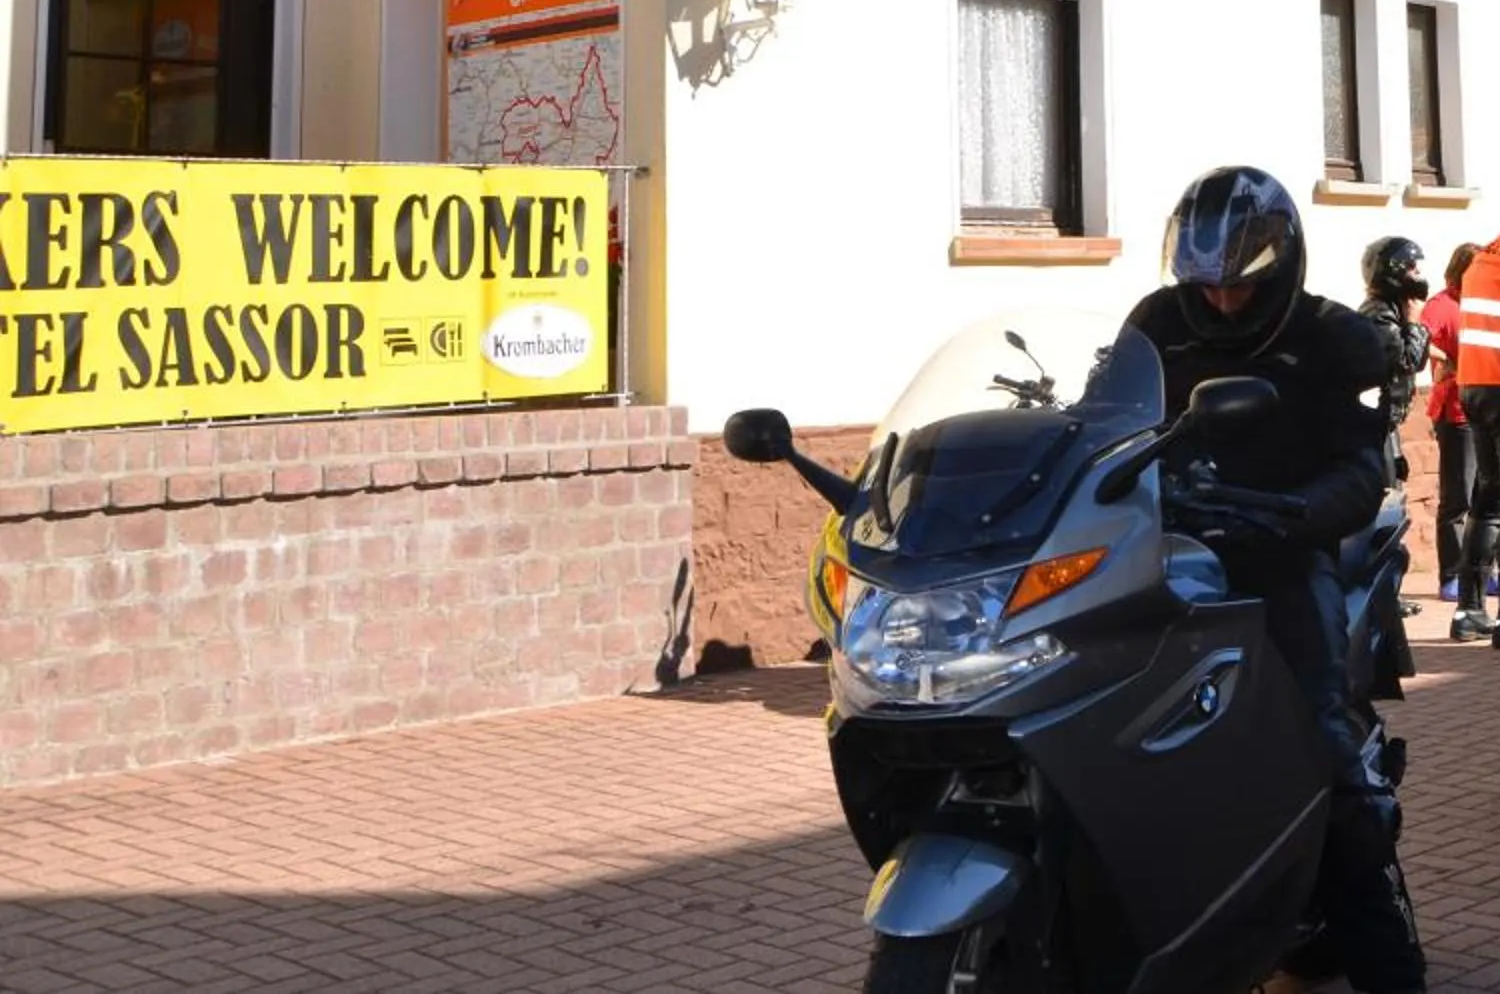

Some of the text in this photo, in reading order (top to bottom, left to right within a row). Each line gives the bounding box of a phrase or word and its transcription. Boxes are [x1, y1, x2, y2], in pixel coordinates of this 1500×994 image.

[230, 193, 589, 285] WELCOME!
[0, 304, 366, 398] EL SASSOR
[493, 331, 585, 358] Krombacher
